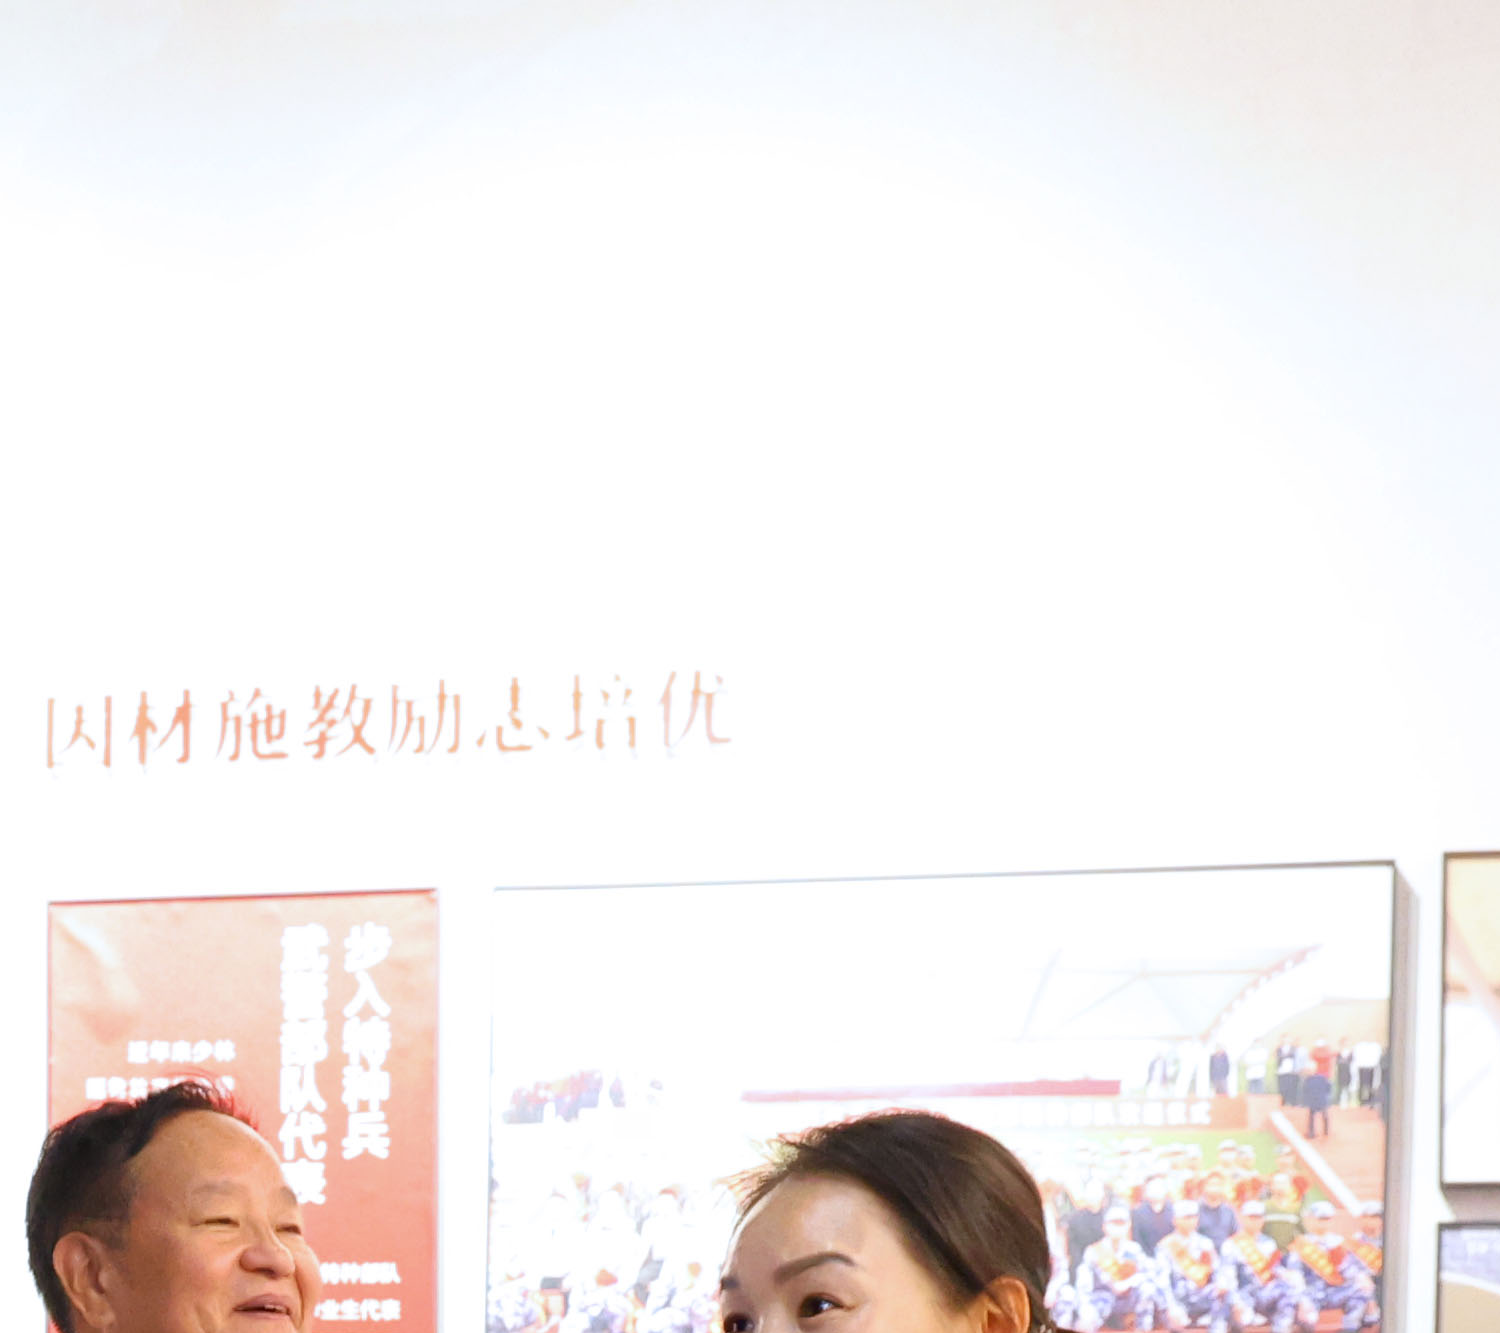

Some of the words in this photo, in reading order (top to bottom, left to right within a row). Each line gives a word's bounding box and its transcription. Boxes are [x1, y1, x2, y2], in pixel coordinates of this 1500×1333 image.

[45, 670, 732, 770] 因材施教励志培优
[342, 921, 392, 1160] 步入特种兵
[314, 1299, 401, 1321] 业生代表
